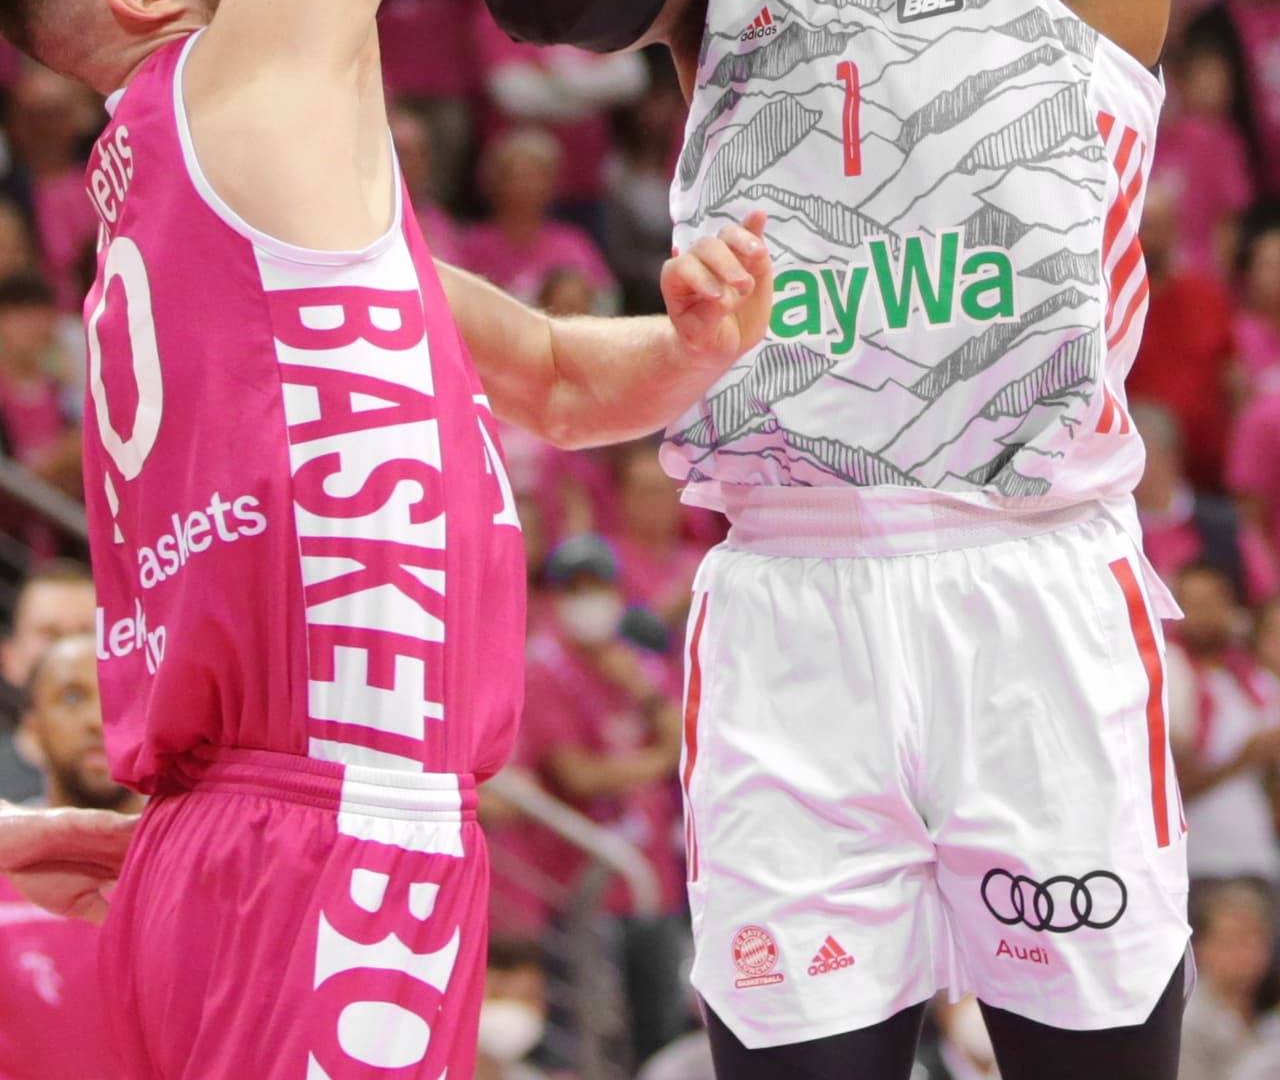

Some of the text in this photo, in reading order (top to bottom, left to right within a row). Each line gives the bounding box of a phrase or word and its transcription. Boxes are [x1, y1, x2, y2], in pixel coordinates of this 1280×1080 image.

[740, 24, 777, 42] adidas
[836, 60, 861, 177] 1
[770, 232, 1013, 356] ayWa
[137, 490, 267, 589] askets
[808, 955, 855, 976] adidas
[996, 938, 1048, 965] Audi
